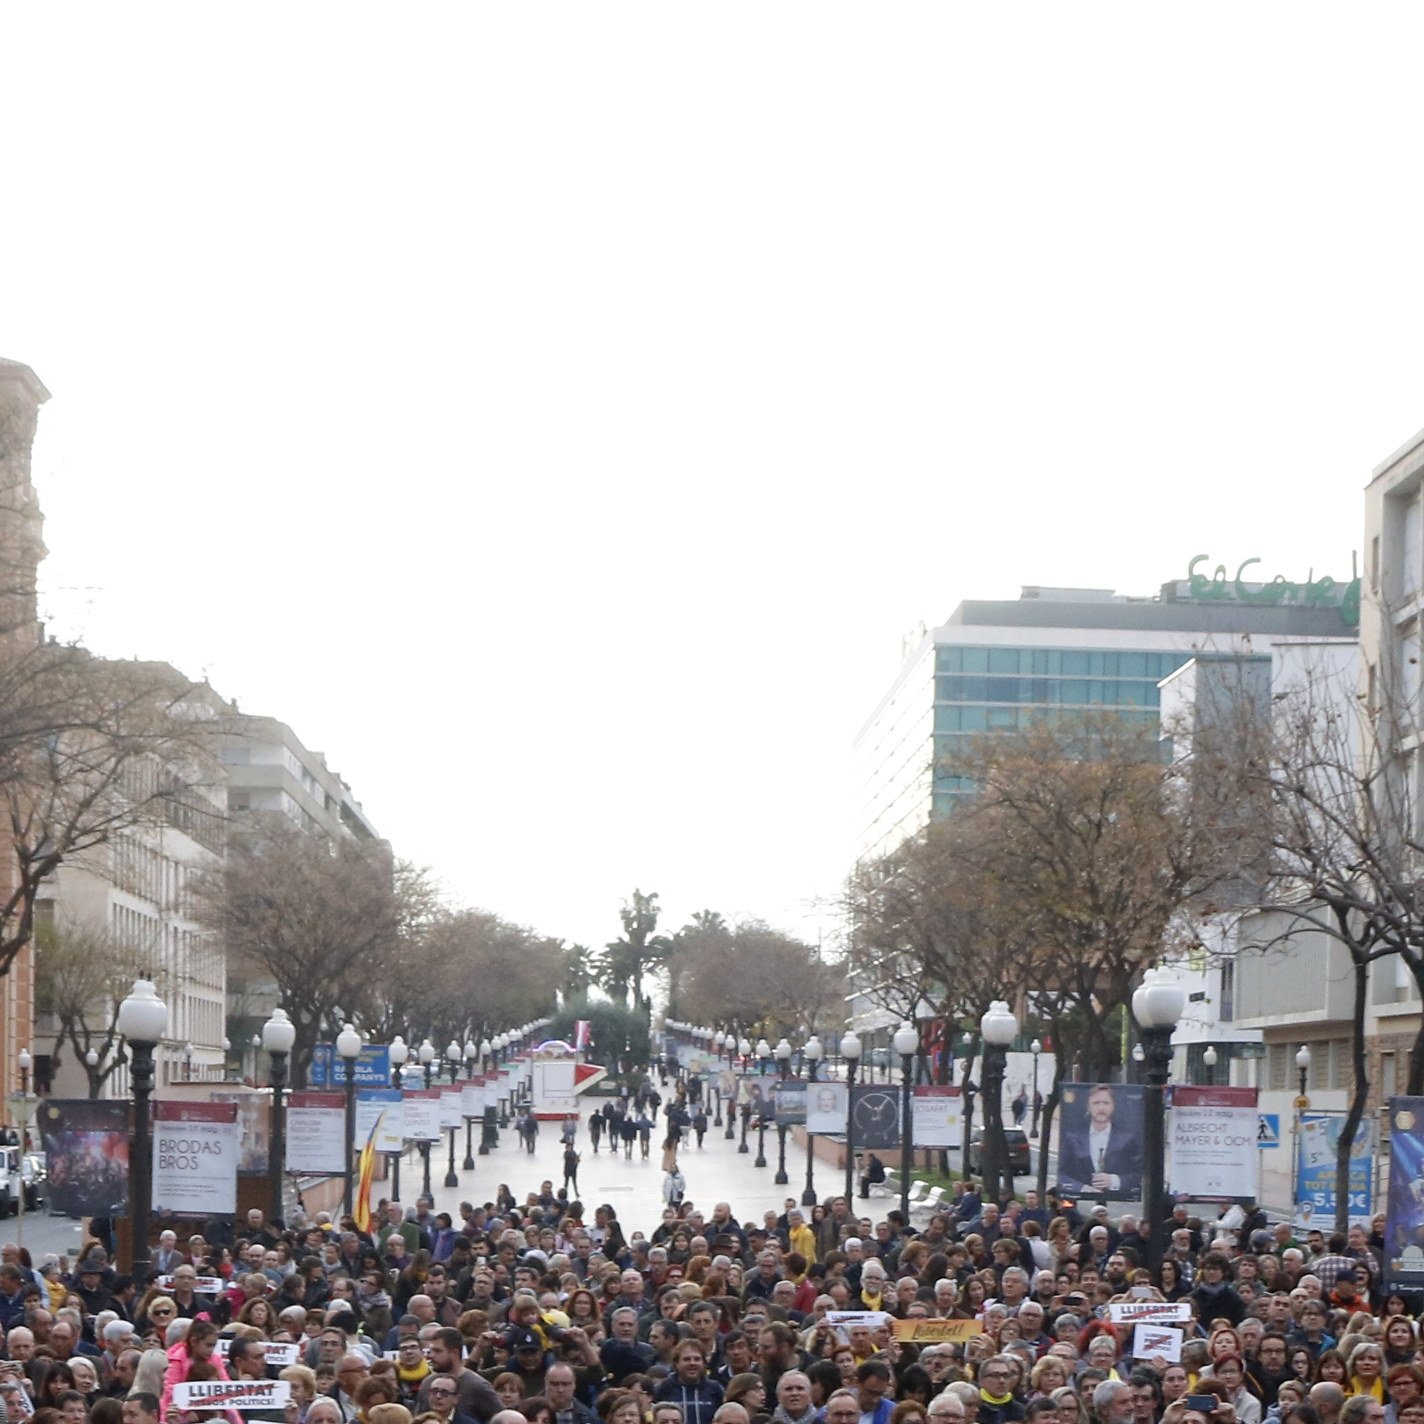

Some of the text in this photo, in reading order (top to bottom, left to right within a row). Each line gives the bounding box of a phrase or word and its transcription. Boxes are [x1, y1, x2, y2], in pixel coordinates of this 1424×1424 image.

[334, 1065, 374, 1073] RABLA
[159, 1139, 222, 1155] BRODAS
[159, 1155, 198, 1170] BROS
[188, 1384, 274, 1397] LLIBERTAT
